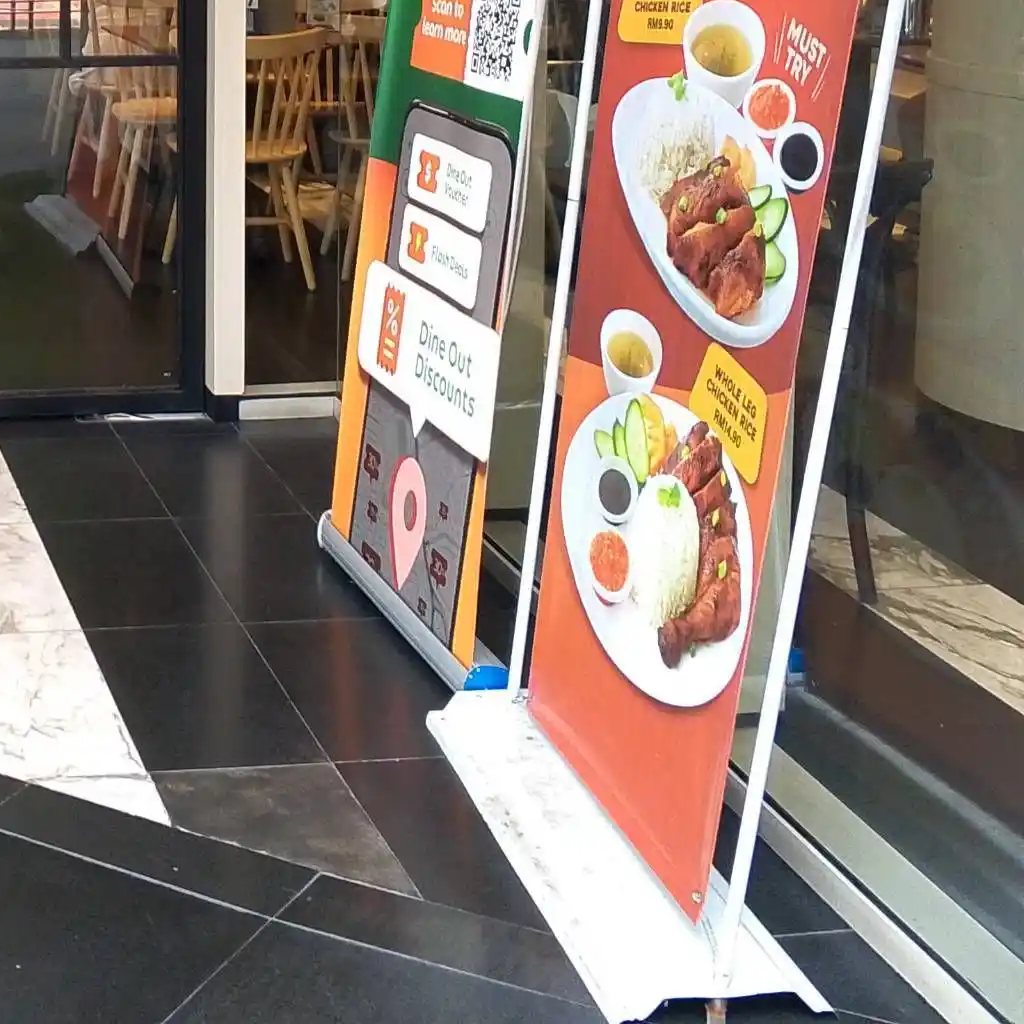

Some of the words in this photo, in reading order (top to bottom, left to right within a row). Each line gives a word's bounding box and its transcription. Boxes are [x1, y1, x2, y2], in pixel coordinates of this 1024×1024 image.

[422, 15, 443, 39] learn
[444, 26, 467, 45] more
[454, 0, 464, 20] to
[634, 1, 668, 12] CHICKEN
[671, 1, 692, 13] RICE
[784, 46, 813, 86] TRY
[787, 17, 826, 69] MUST
[419, 320, 446, 360] Dine
[448, 341, 472, 378] Out
[415, 353, 475, 417] Discounts
[715, 364, 741, 403] WHOLE
[742, 394, 757, 419] LEG
[706, 379, 739, 421] CHICKEN
[740, 414, 758, 442] RICE
[713, 409, 742, 449] RM14.90
